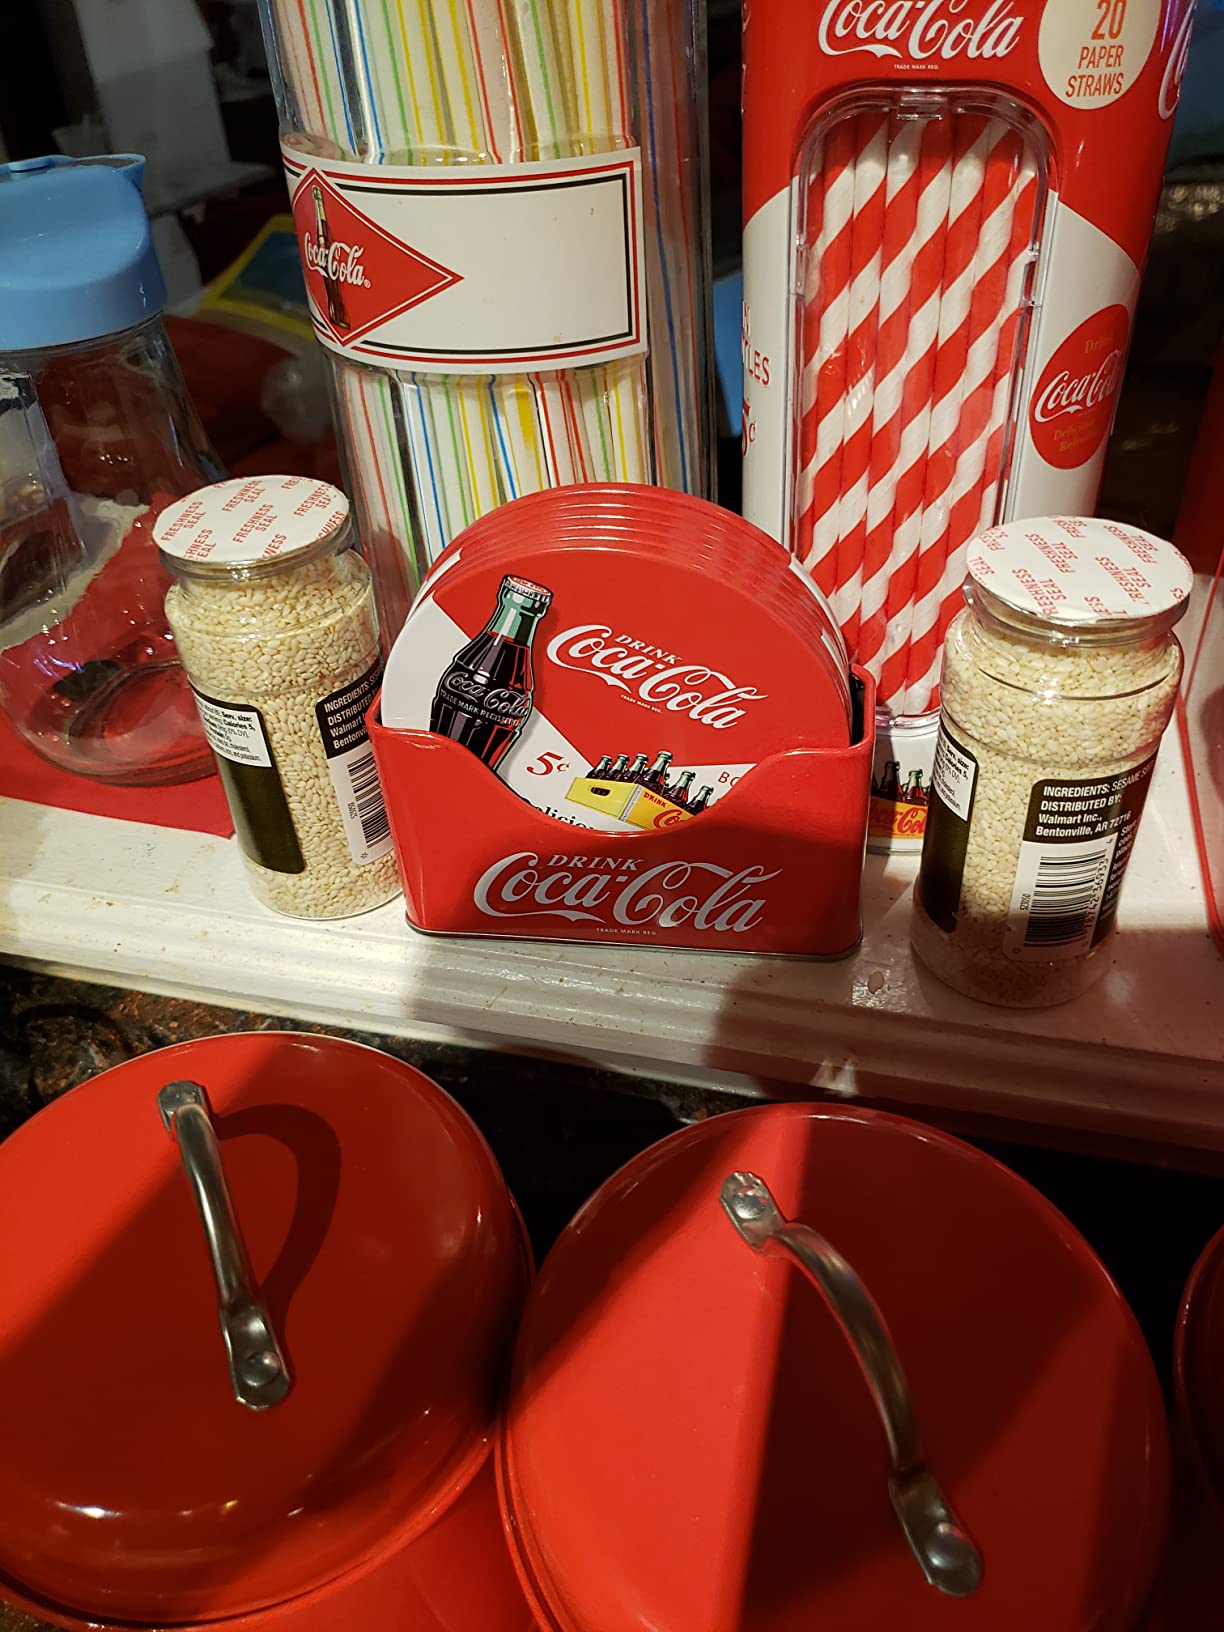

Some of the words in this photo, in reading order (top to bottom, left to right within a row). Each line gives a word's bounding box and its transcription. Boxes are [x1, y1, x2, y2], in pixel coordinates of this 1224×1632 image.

[1091, 0, 1128, 41] 20
[1077, 45, 1123, 70] PAPER
[1065, 72, 1124, 98] STRAWS
[222, 480, 263, 512] FRESHNESS
[243, 488, 266, 504] SEAL
[161, 501, 204, 542] FRESHNESS
[184, 511, 207, 529] SEAL
[232, 503, 275, 543] FRESHNESS
[255, 514, 278, 532] SEAL
[197, 542, 216, 558] EAL
[1024, 533, 1076, 574] FRESHNESS
[1051, 541, 1079, 560] SEAL
[1104, 525, 1158, 564] FRESHNESS
[1132, 534, 1159, 552] SEAL
[1038, 578, 1068, 602] SEAL
[1095, 556, 1145, 603] RESHNESS
[1123, 566, 1152, 589] SEAL
[1012, 568, 1060, 616] RESHNESS
[614, 634, 683, 665] DRINK
[546, 624, 769, 729] Coca-Cola
[327, 693, 373, 726] DISTRIBUTED
[440, 689, 458, 704] TRADE
[458, 700, 479, 714] MARK
[330, 716, 362, 737] Walmart
[526, 751, 570, 776] 5¢
[643, 791, 668, 808] DRINK
[1040, 797, 1106, 812] DISTRIBUTED
[1107, 793, 1122, 806] BY:
[1043, 784, 1111, 798] INGREDIENTS:
[1035, 825, 1094, 837] Bentonville,
[1095, 821, 1108, 833] AR
[1038, 813, 1081, 824] Walmart
[547, 854, 645, 871] DRINK
[473, 851, 784, 932] Coca-Cola
